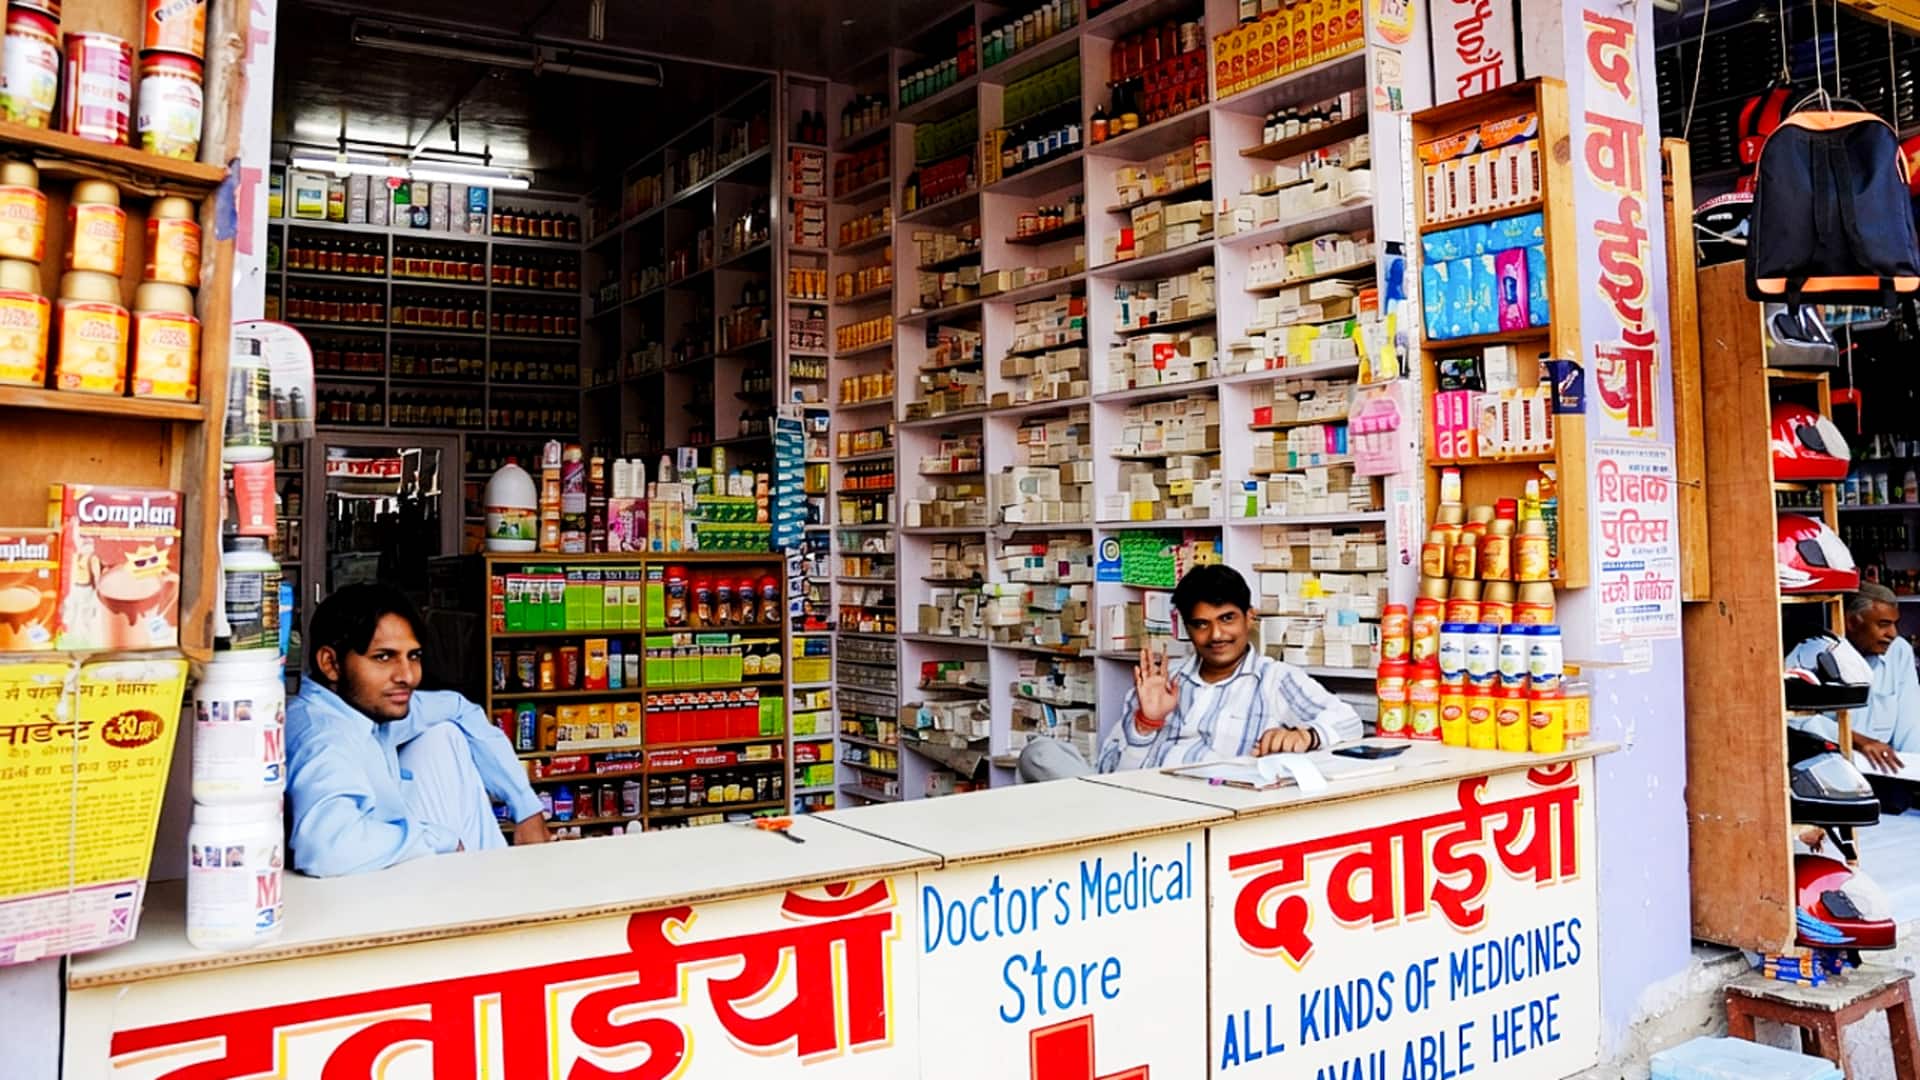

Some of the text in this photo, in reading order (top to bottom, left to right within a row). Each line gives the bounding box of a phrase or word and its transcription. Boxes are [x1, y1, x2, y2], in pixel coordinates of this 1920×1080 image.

[0, 537, 48, 562] mplan
[78, 496, 175, 530] Complan
[1601, 509, 1668, 558] पुलिस
[923, 841, 1192, 953] Doctor's Medical
[1229, 761, 1580, 963] दवाईयाँ
[1000, 949, 1122, 1024] Store
[1221, 917, 1582, 1070] ALL KINDS OF MEDICINES
[1315, 993, 1561, 1080] LABLE HERE
